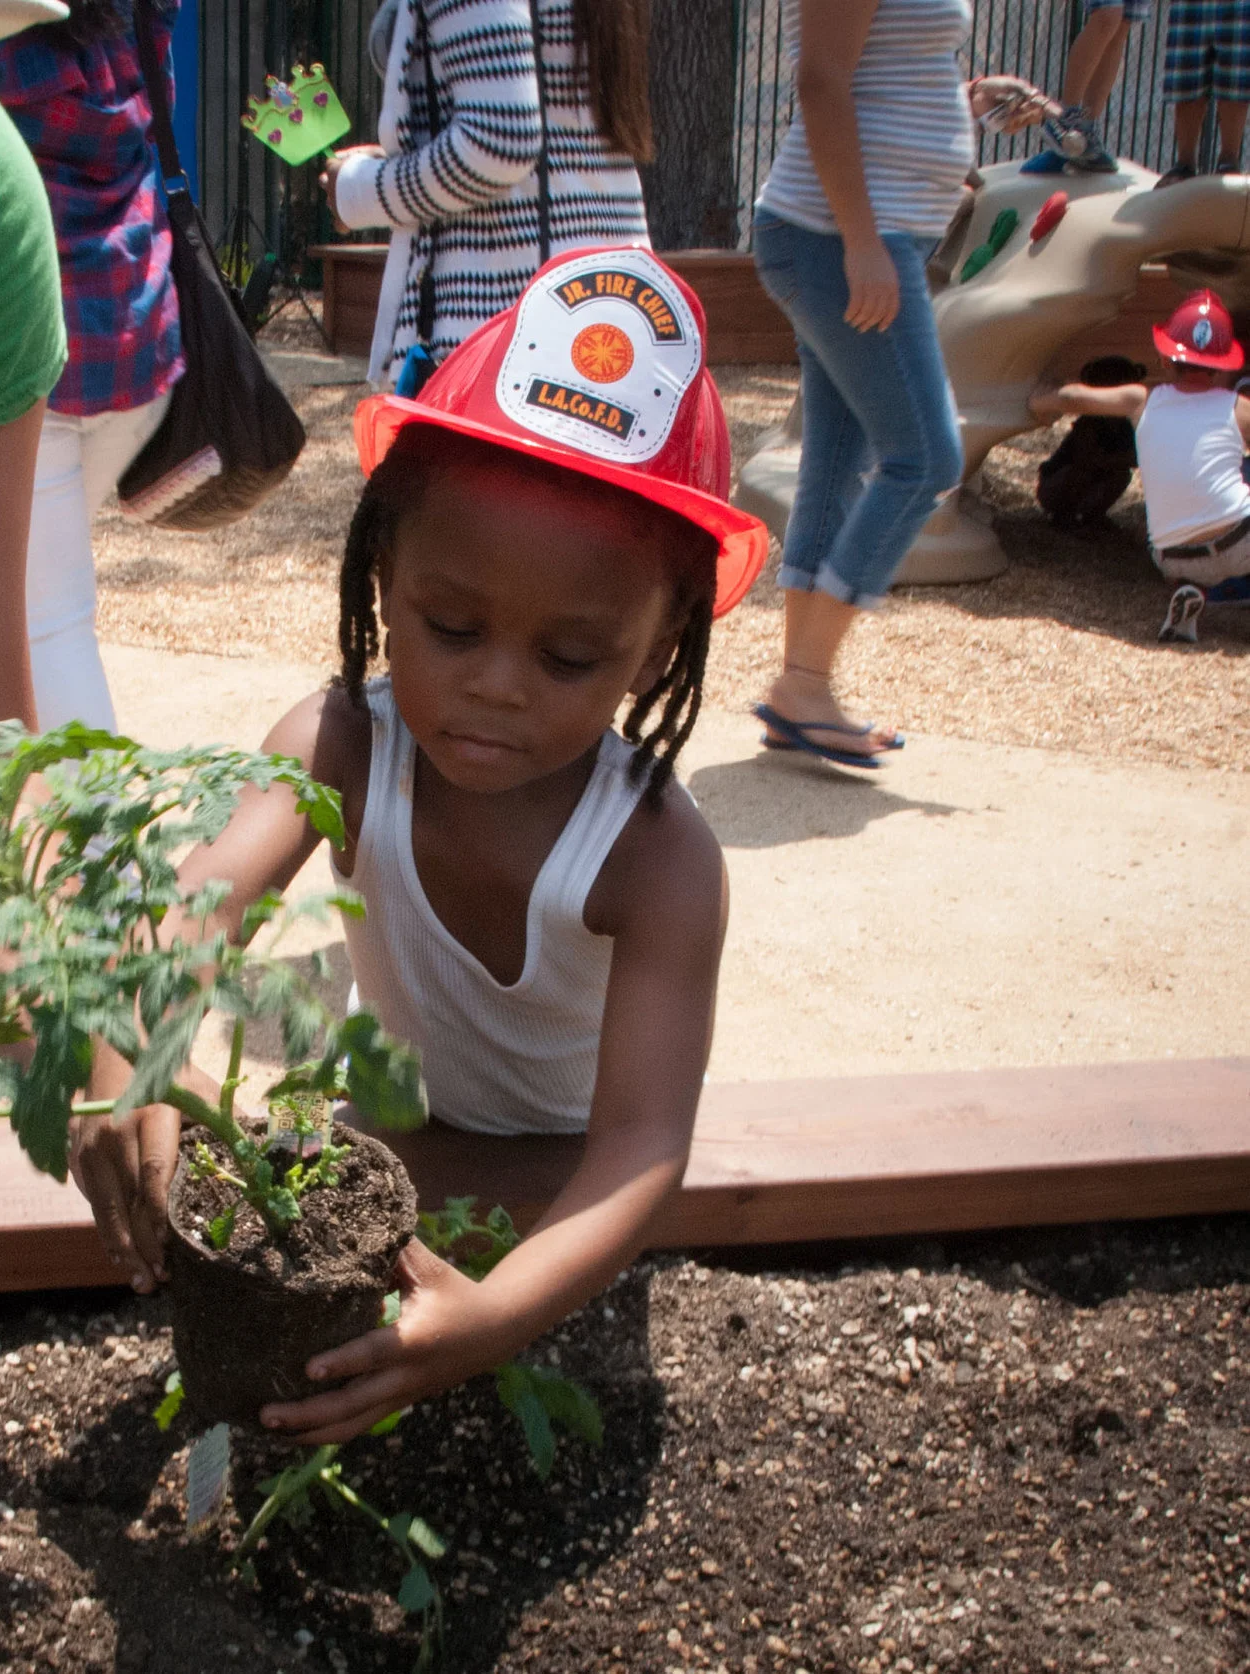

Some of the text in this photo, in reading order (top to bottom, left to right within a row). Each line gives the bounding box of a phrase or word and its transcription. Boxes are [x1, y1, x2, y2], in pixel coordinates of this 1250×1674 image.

[562, 273, 676, 334] JR. FIRE CHIEF
[538, 384, 623, 432] L.A.Co.F.D.
